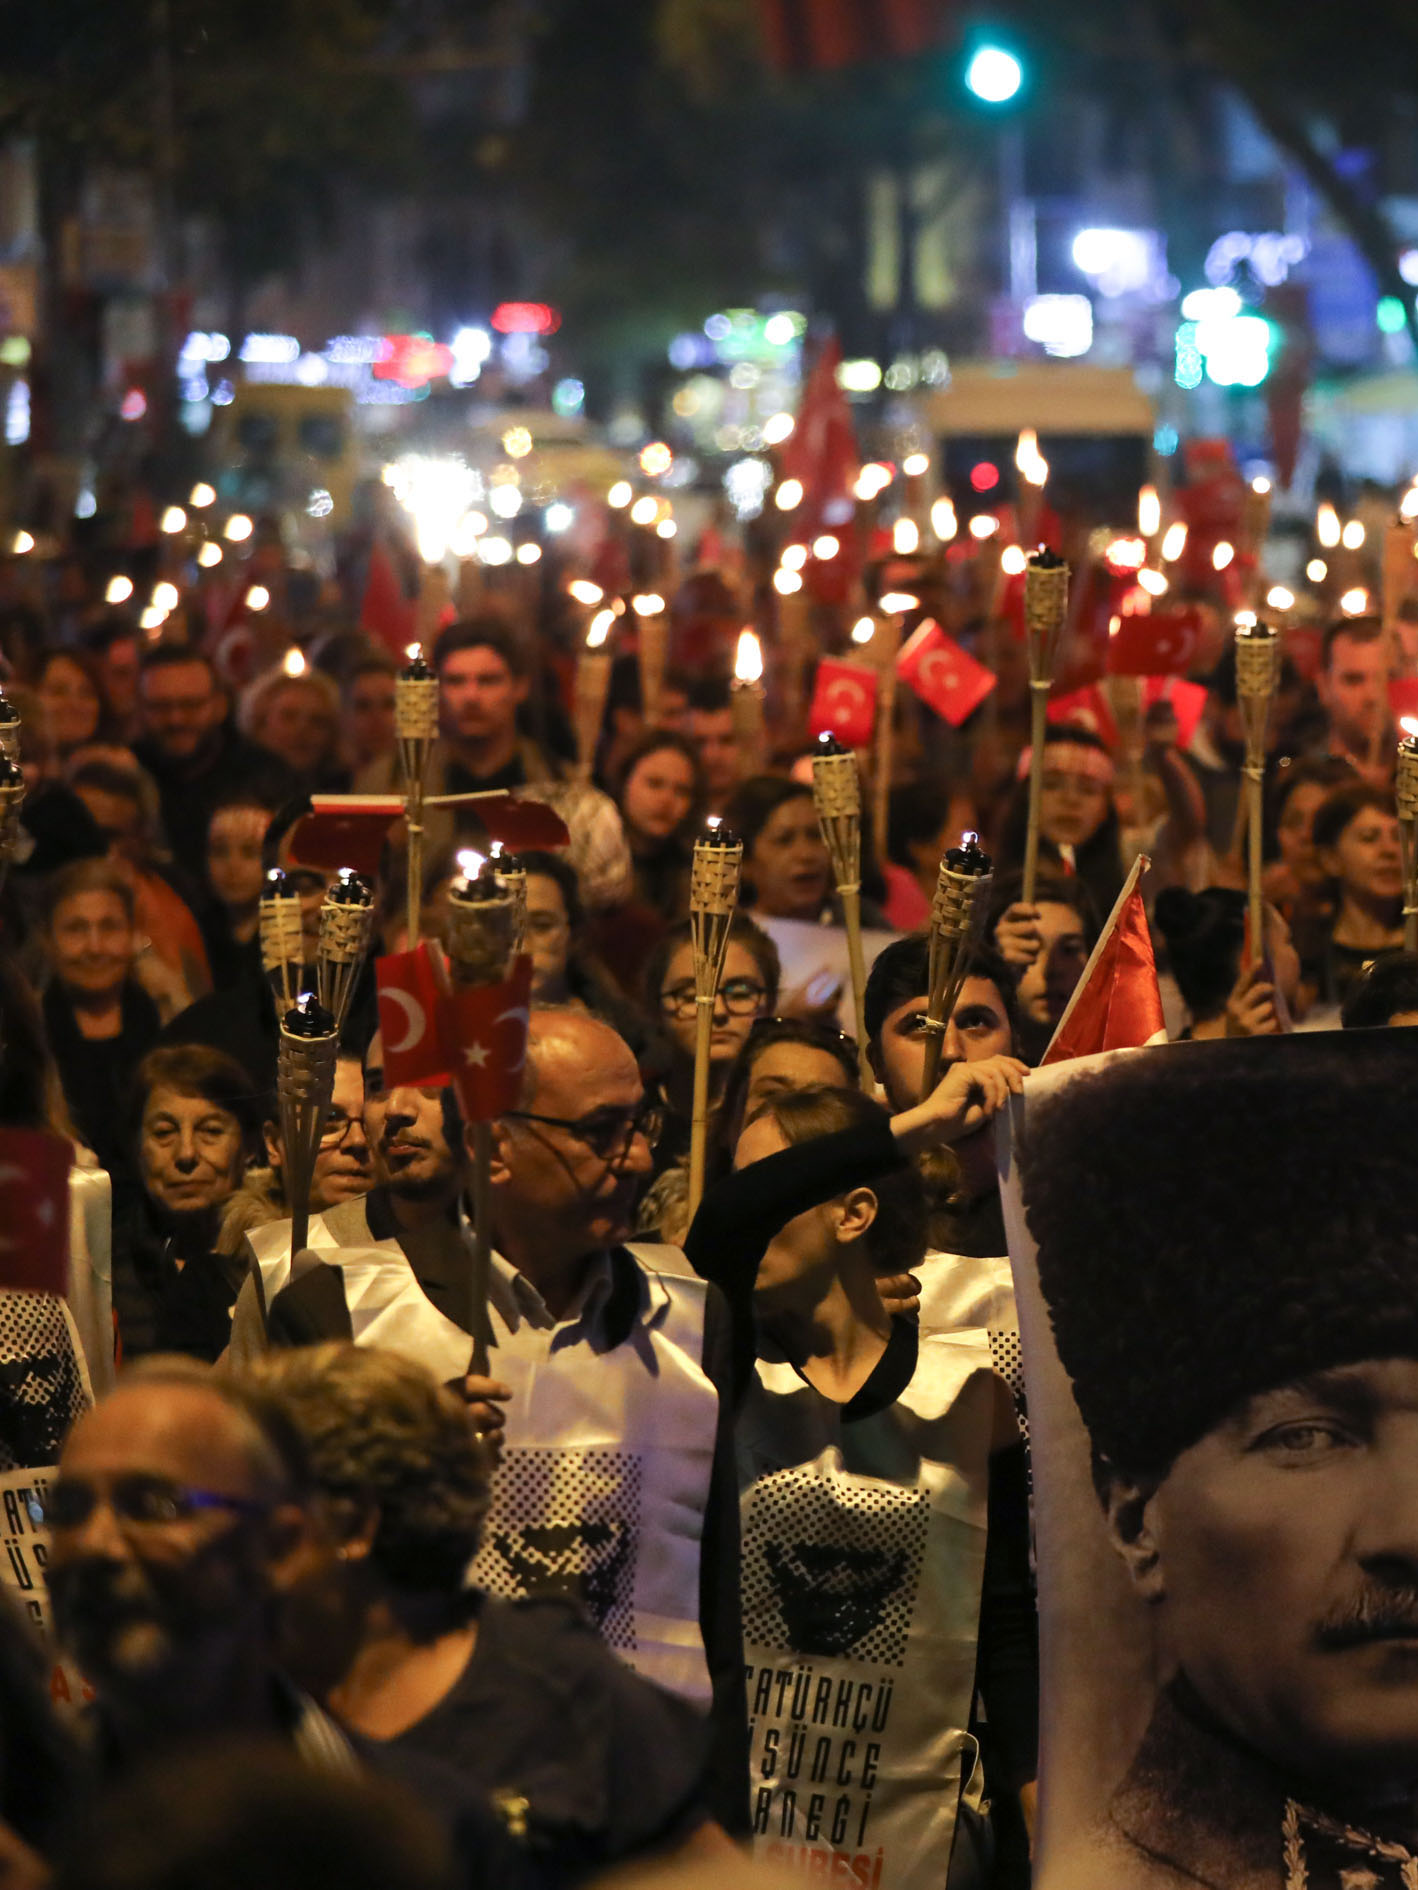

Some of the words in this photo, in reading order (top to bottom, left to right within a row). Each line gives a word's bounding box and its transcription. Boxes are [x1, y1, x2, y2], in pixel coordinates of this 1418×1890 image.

[746, 1665, 895, 1733] ATÜRKÇÜ
[749, 1717, 882, 1791] ŞÜNCE
[754, 1786, 872, 1847] RNEĞİ
